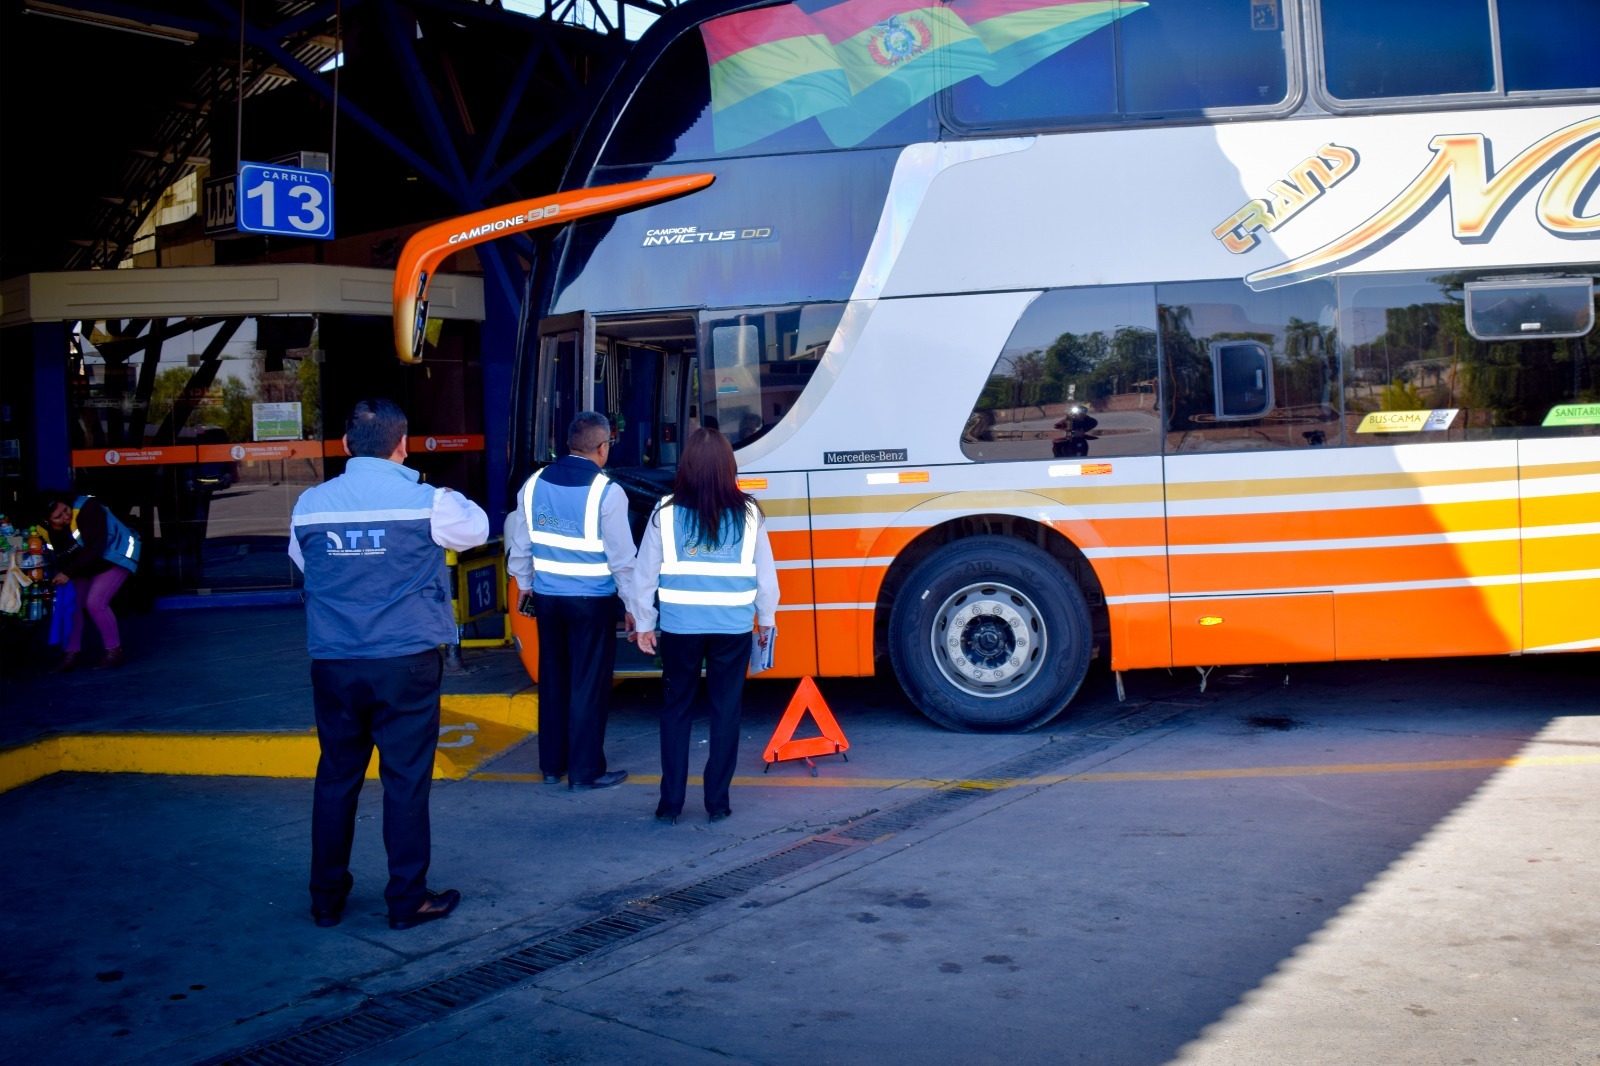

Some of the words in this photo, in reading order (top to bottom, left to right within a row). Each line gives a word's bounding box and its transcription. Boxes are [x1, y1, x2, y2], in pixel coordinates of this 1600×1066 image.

[262, 170, 311, 184] CARRIL
[247, 180, 325, 232] 13
[448, 214, 524, 244] CAMPIONE
[646, 226, 697, 237] CAMPIONE
[642, 230, 736, 246] INVICTUS
[1369, 414, 1421, 424] BUS-CAMA
[827, 451, 904, 463] Mercedes-Benz
[476, 580, 491, 608] 13
